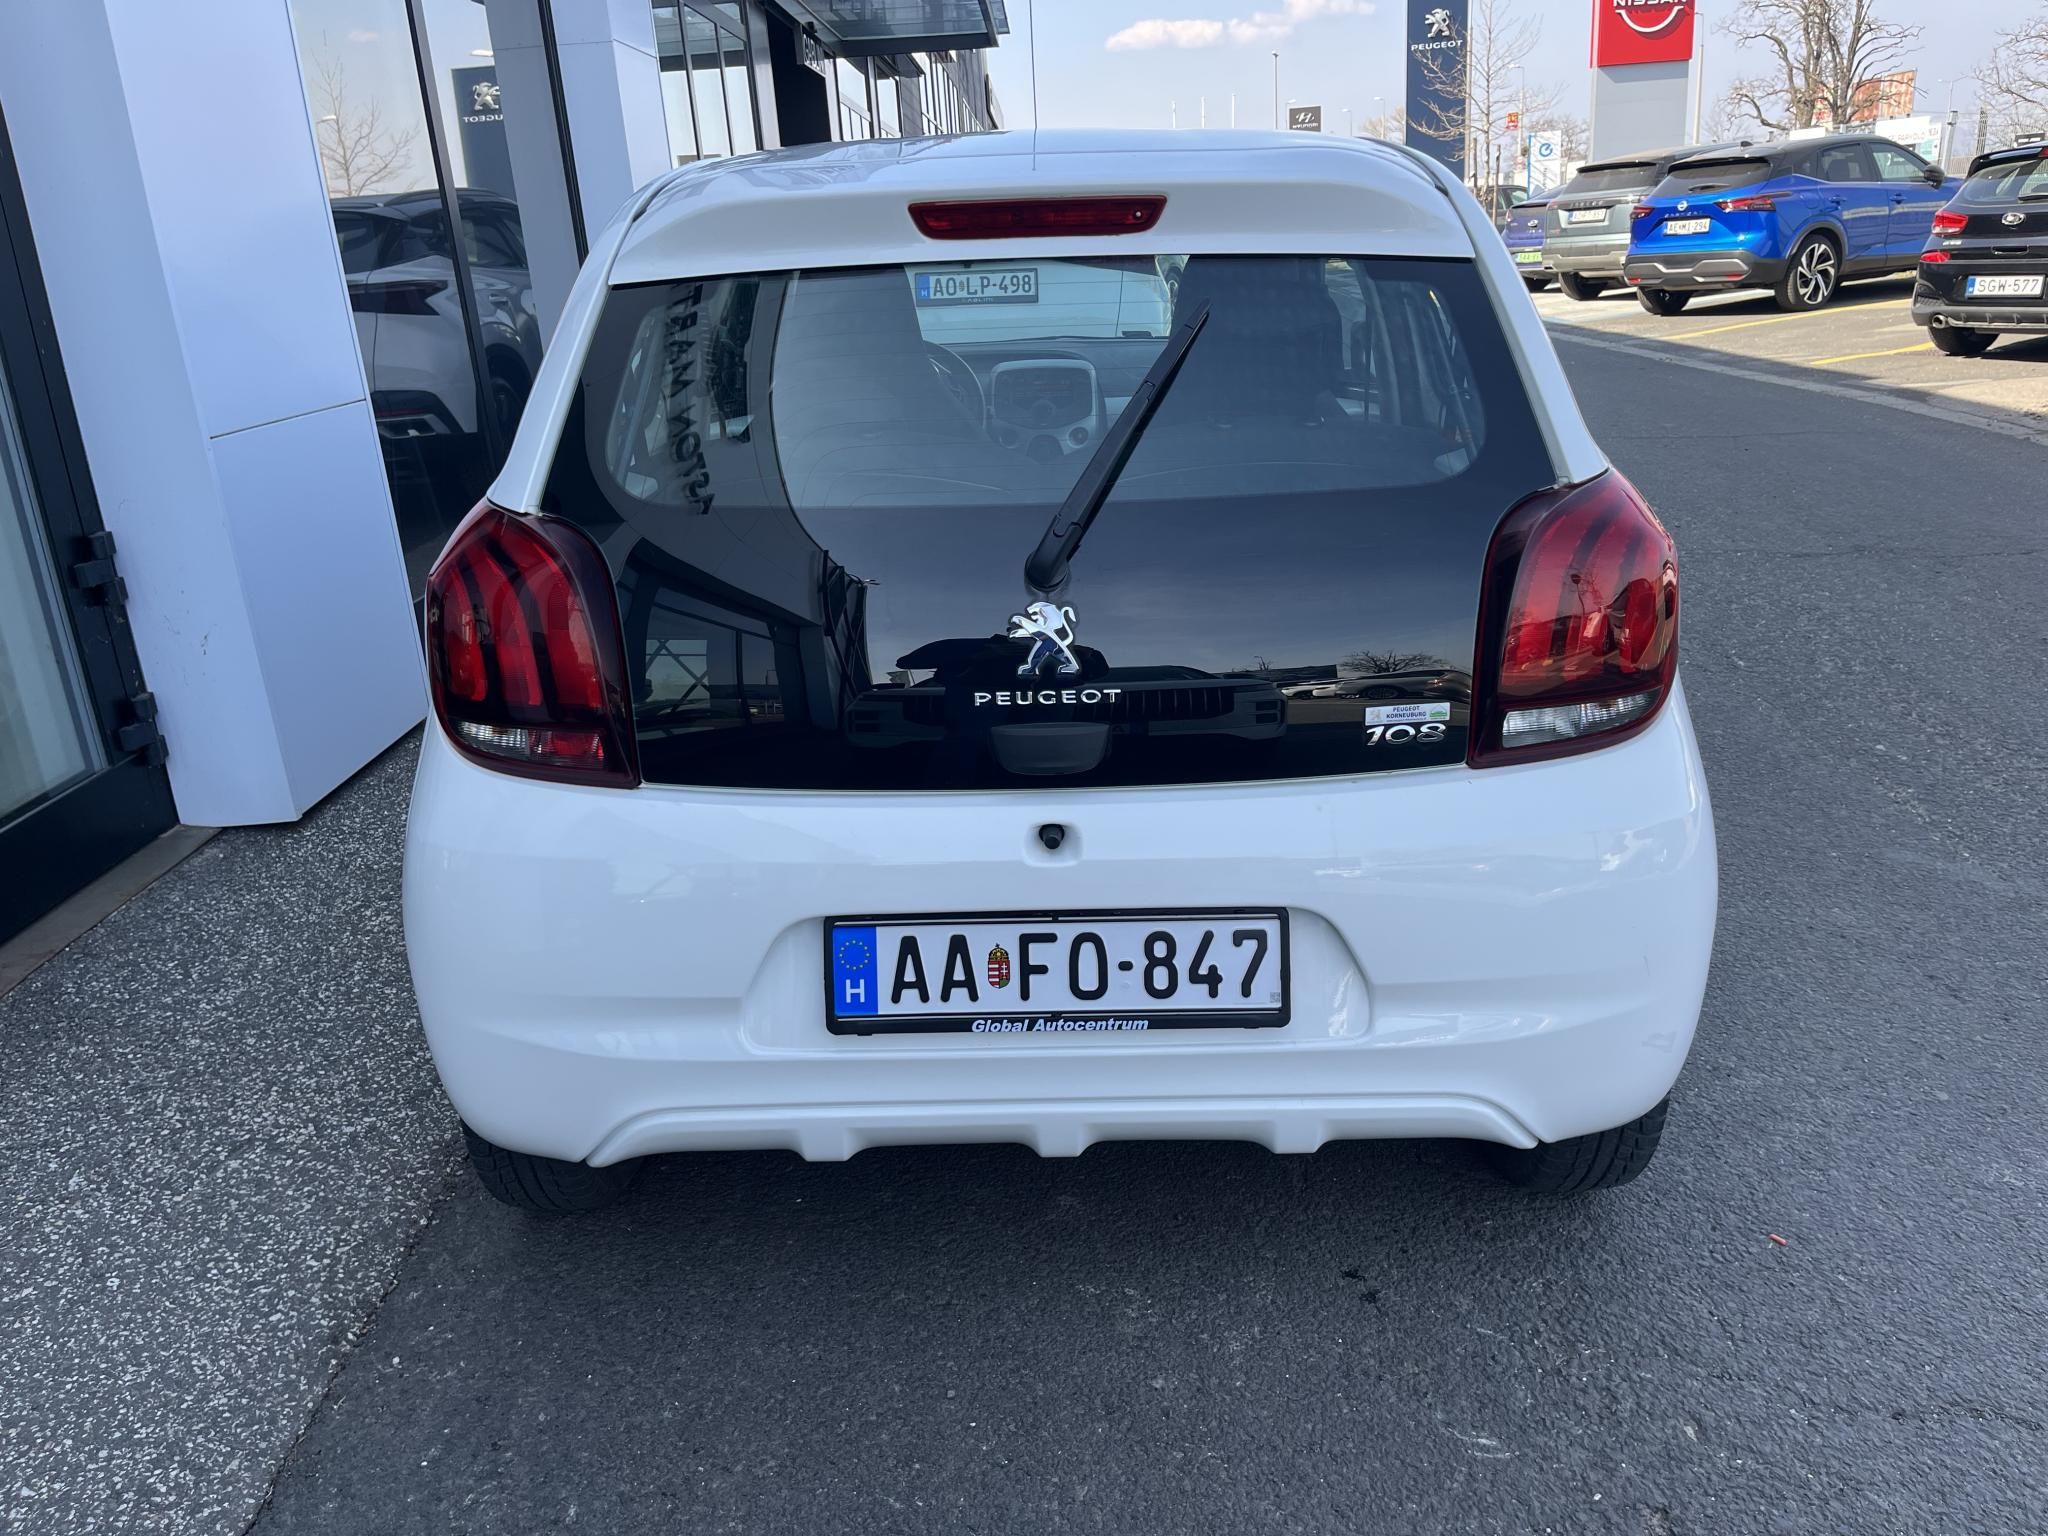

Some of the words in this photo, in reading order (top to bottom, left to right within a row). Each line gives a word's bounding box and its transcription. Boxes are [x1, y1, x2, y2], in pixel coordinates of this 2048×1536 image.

[1410, 40, 1463, 51] PEUGEOT
[966, 274, 1032, 295] LP-498
[1977, 278, 2039, 293] SGW-577
[974, 689, 1121, 706] PEUGEOT
[1386, 711, 1427, 719] KORNEUBURG
[1366, 722, 1446, 746] 108
[1019, 929, 1268, 1001] FO-847
[845, 979, 866, 1004] H
[971, 1019, 1029, 1032] Global
[1032, 1018, 1149, 1032] Autocentrum
